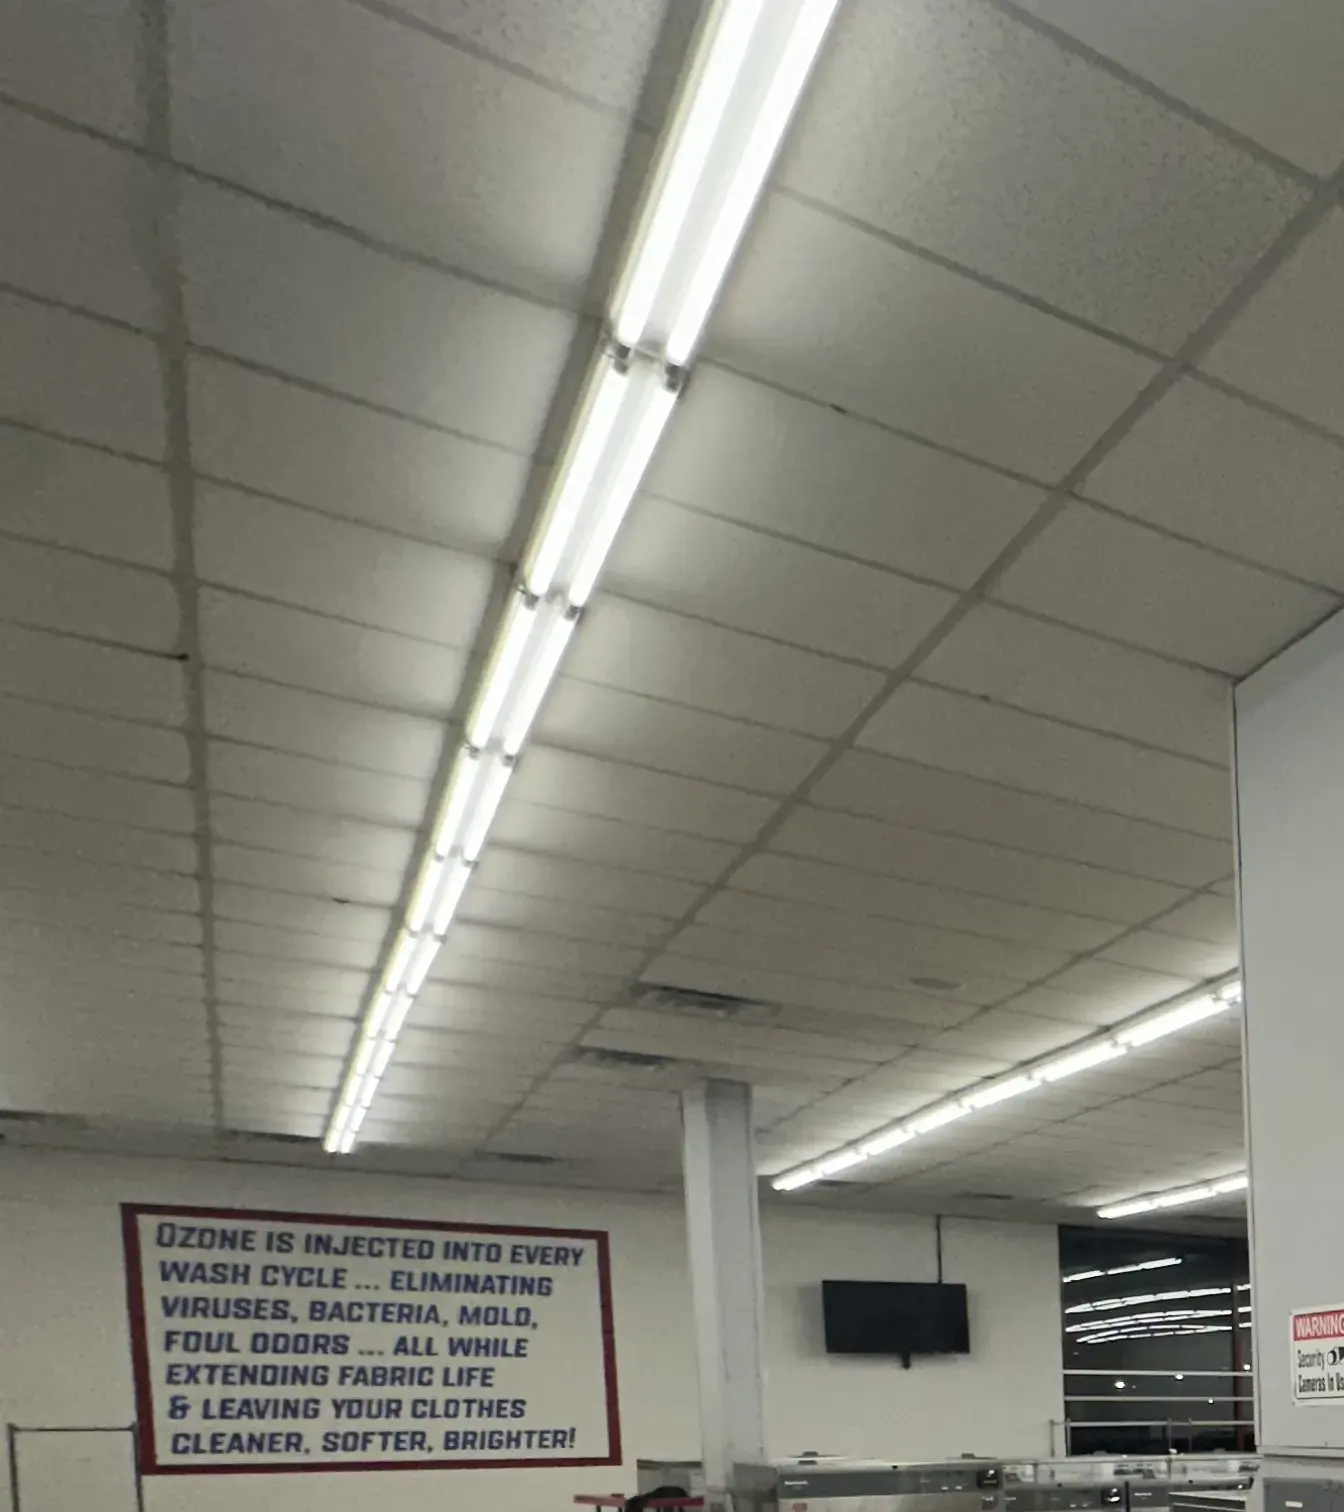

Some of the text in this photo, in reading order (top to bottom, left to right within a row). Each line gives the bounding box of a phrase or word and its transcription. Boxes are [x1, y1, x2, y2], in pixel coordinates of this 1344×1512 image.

[156, 1221, 584, 1266] OZONE IS INJECTED INTO EVERY
[160, 1261, 251, 1285] WASH
[261, 1265, 348, 1289] CYCLE
[390, 1270, 553, 1296] ELIMINATING
[161, 1296, 538, 1329] VIRUSES, BACTERIA, MOLD,
[164, 1330, 241, 1353] FOUL
[250, 1332, 350, 1355] ODORS
[393, 1336, 438, 1356] ALL
[448, 1337, 529, 1358] WHILE
[1298, 1348, 1325, 1371] Security
[165, 1363, 495, 1387] EXTENDING FABRIC LIFE
[1298, 1374, 1326, 1393] Cameras
[168, 1395, 527, 1420] & LEAVING YOUR CLOTHES
[171, 1427, 576, 1454] CLEANER, SOFTER, BRIGHTER!
